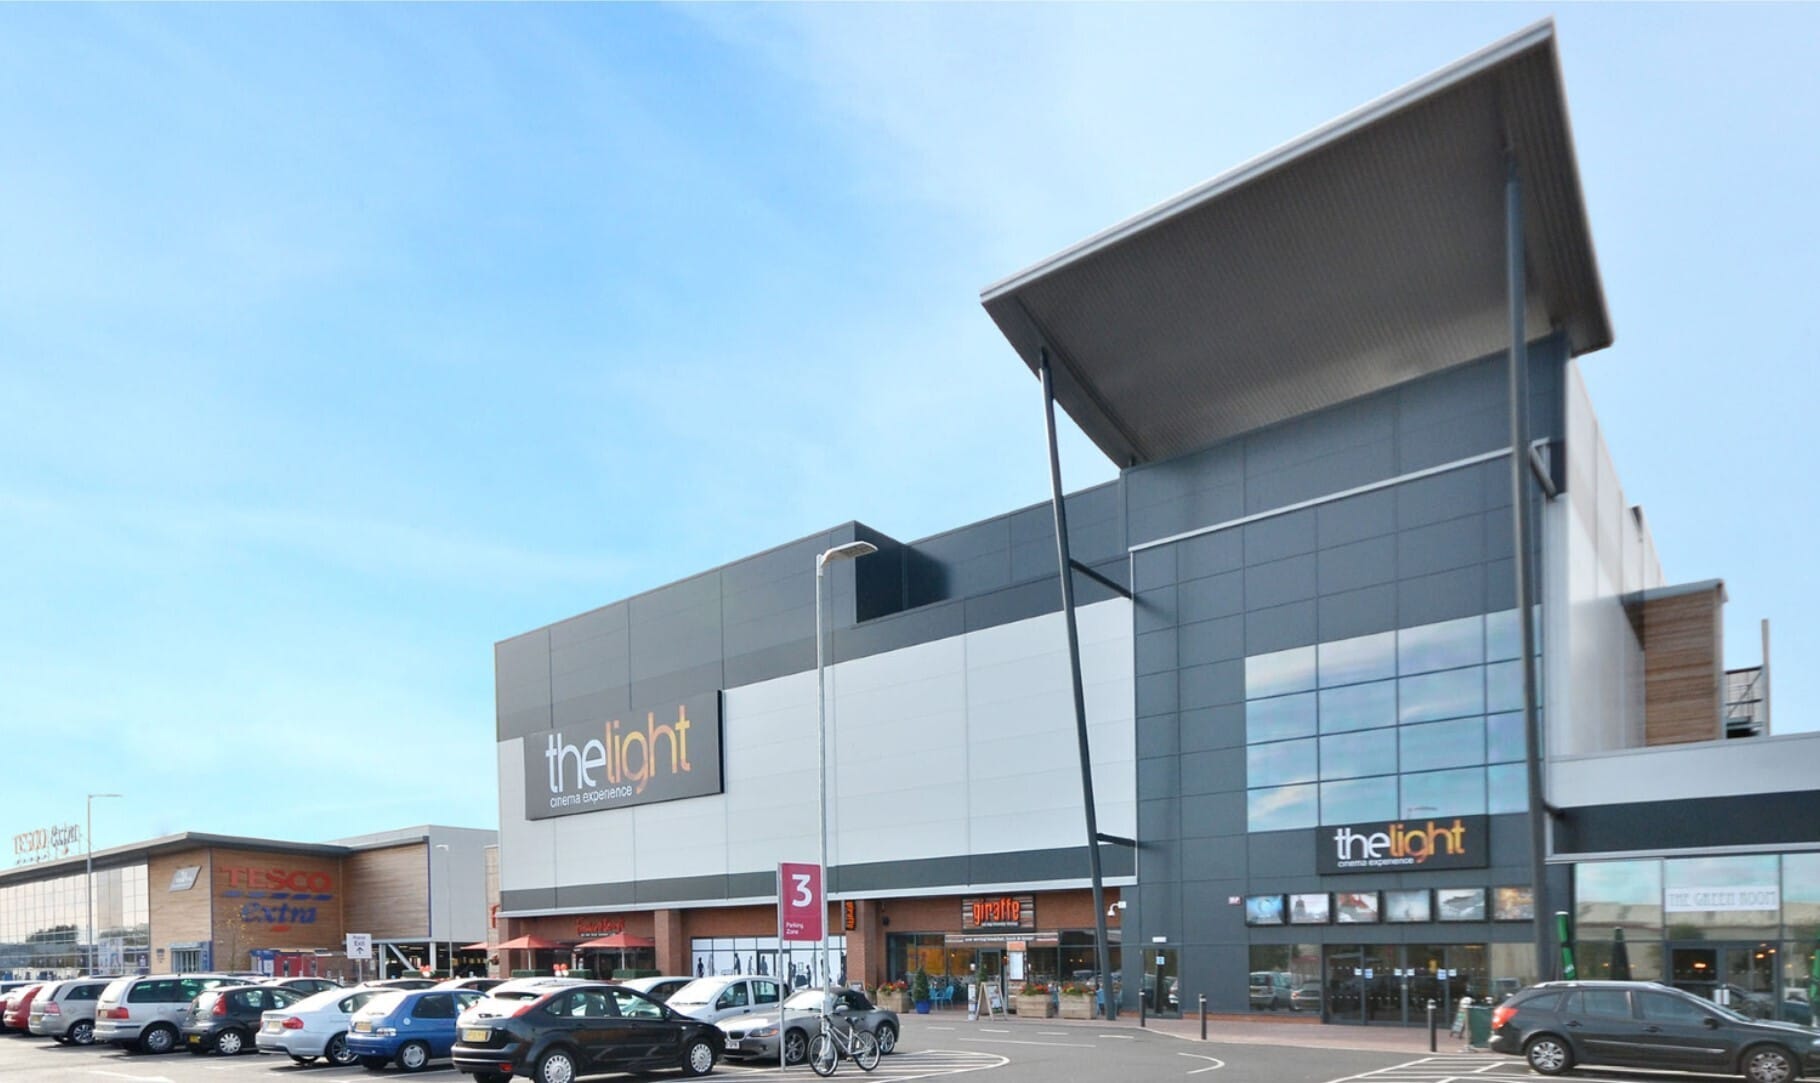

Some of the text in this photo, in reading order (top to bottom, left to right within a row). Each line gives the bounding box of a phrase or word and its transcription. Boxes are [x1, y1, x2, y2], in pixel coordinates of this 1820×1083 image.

[550, 785, 633, 808] cinema experience
[1338, 857, 1414, 868] cinema experience
[221, 866, 332, 892] TESCO
[791, 873, 813, 908] 3
[973, 897, 1020, 927] giraffe
